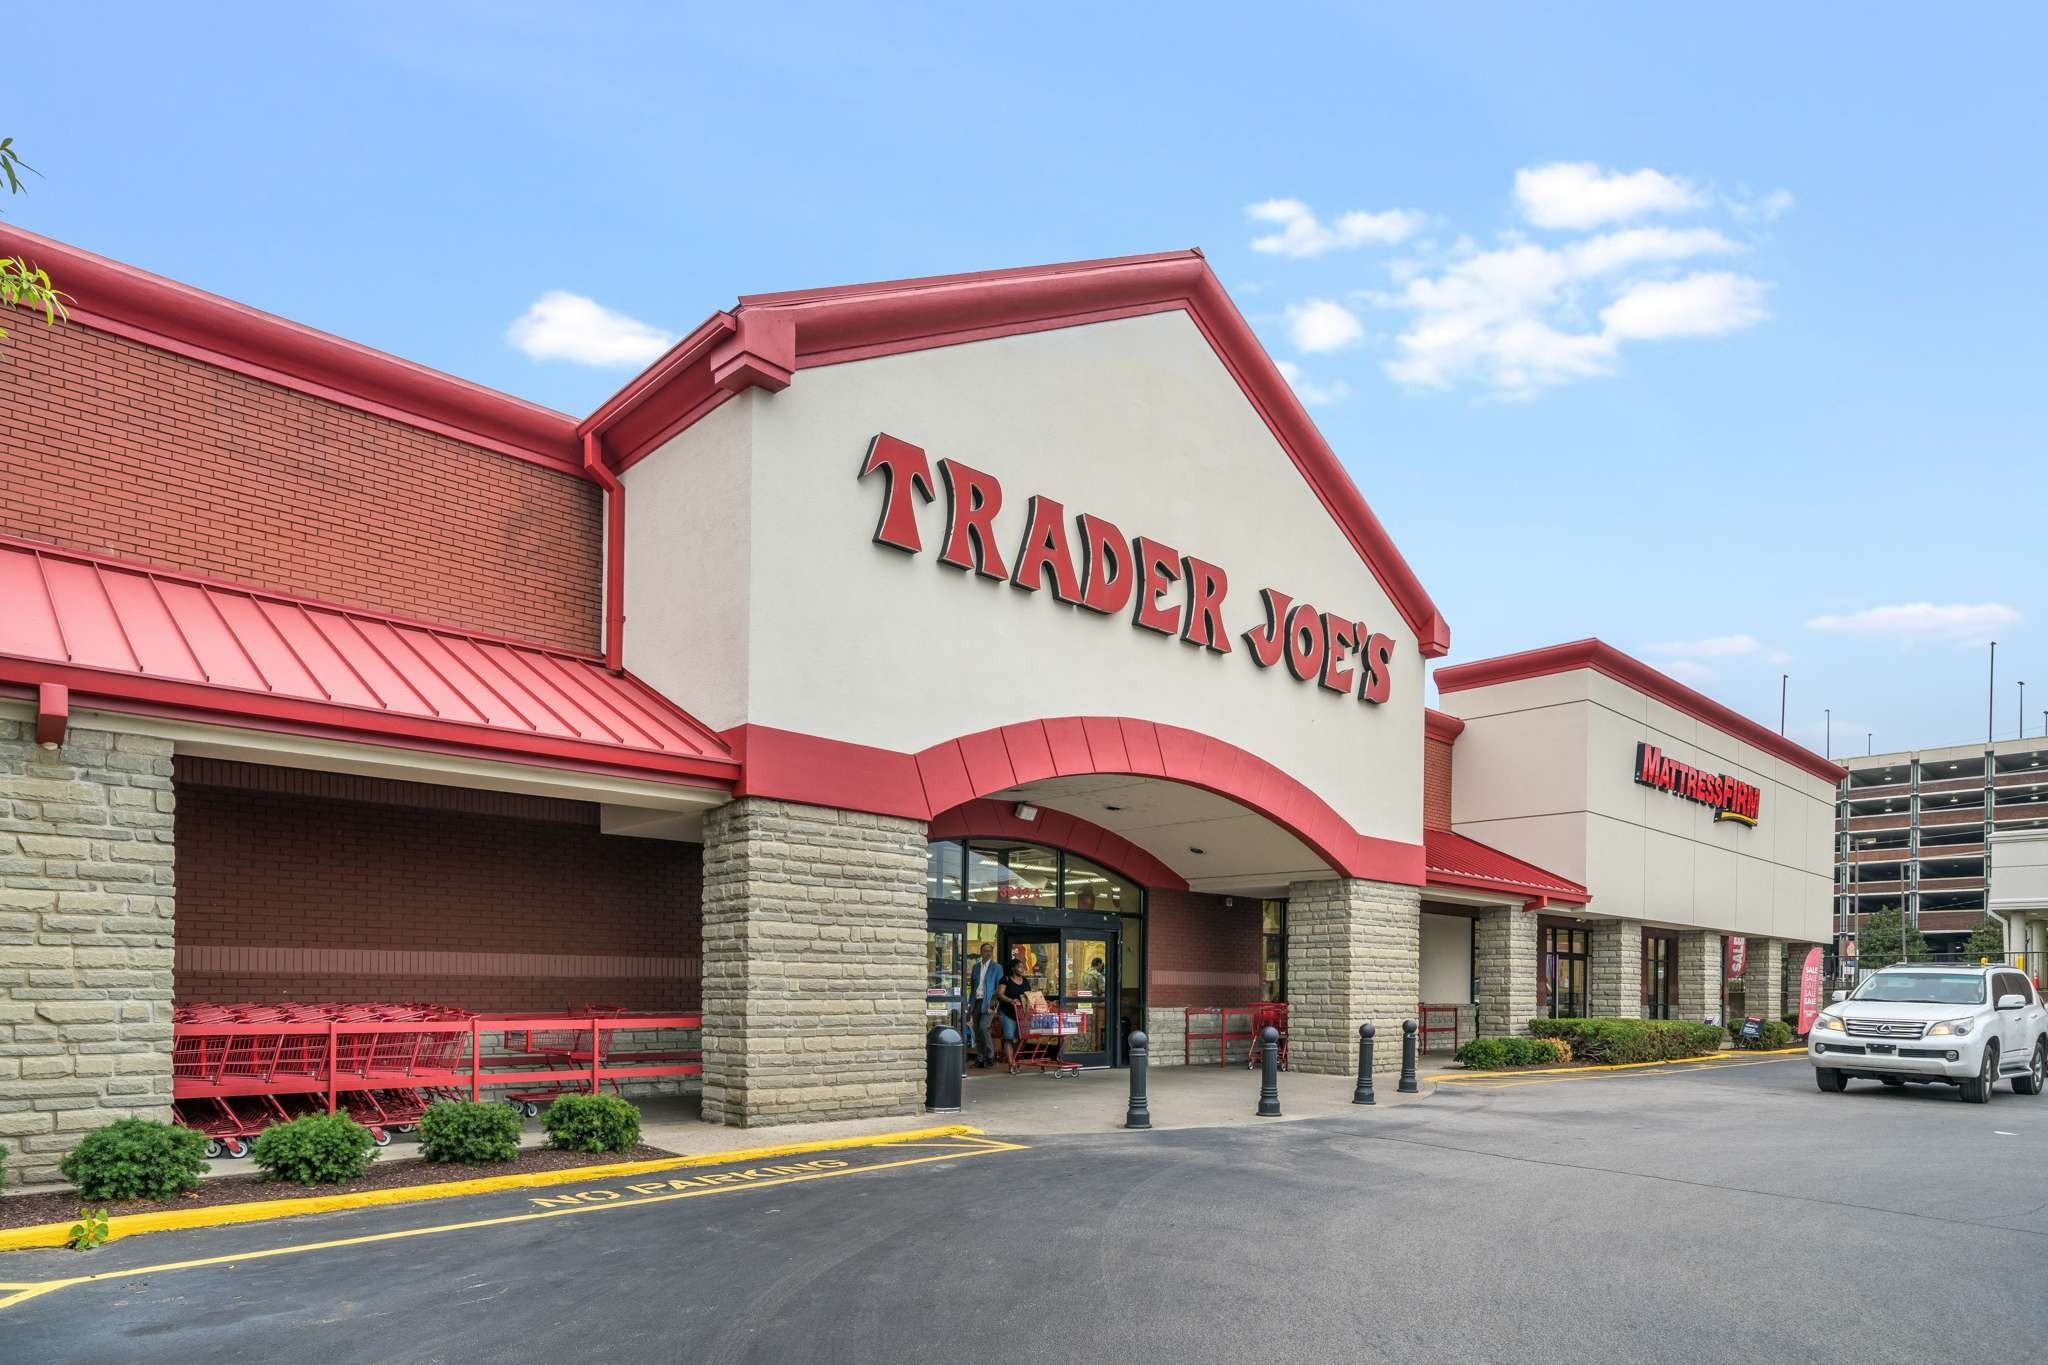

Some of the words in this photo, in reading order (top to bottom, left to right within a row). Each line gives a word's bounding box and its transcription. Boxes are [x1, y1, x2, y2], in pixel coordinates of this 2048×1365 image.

[858, 432, 1231, 653] TRADER
[1242, 588, 1396, 703] JOE'S
[1640, 742, 1722, 808] MATTRESS
[1722, 774, 1761, 820] FIRM
[1732, 936, 1745, 972] SALE
[1805, 966, 1818, 974] SALE
[529, 1189, 621, 1208] NO
[626, 1158, 849, 1195] PARKING
